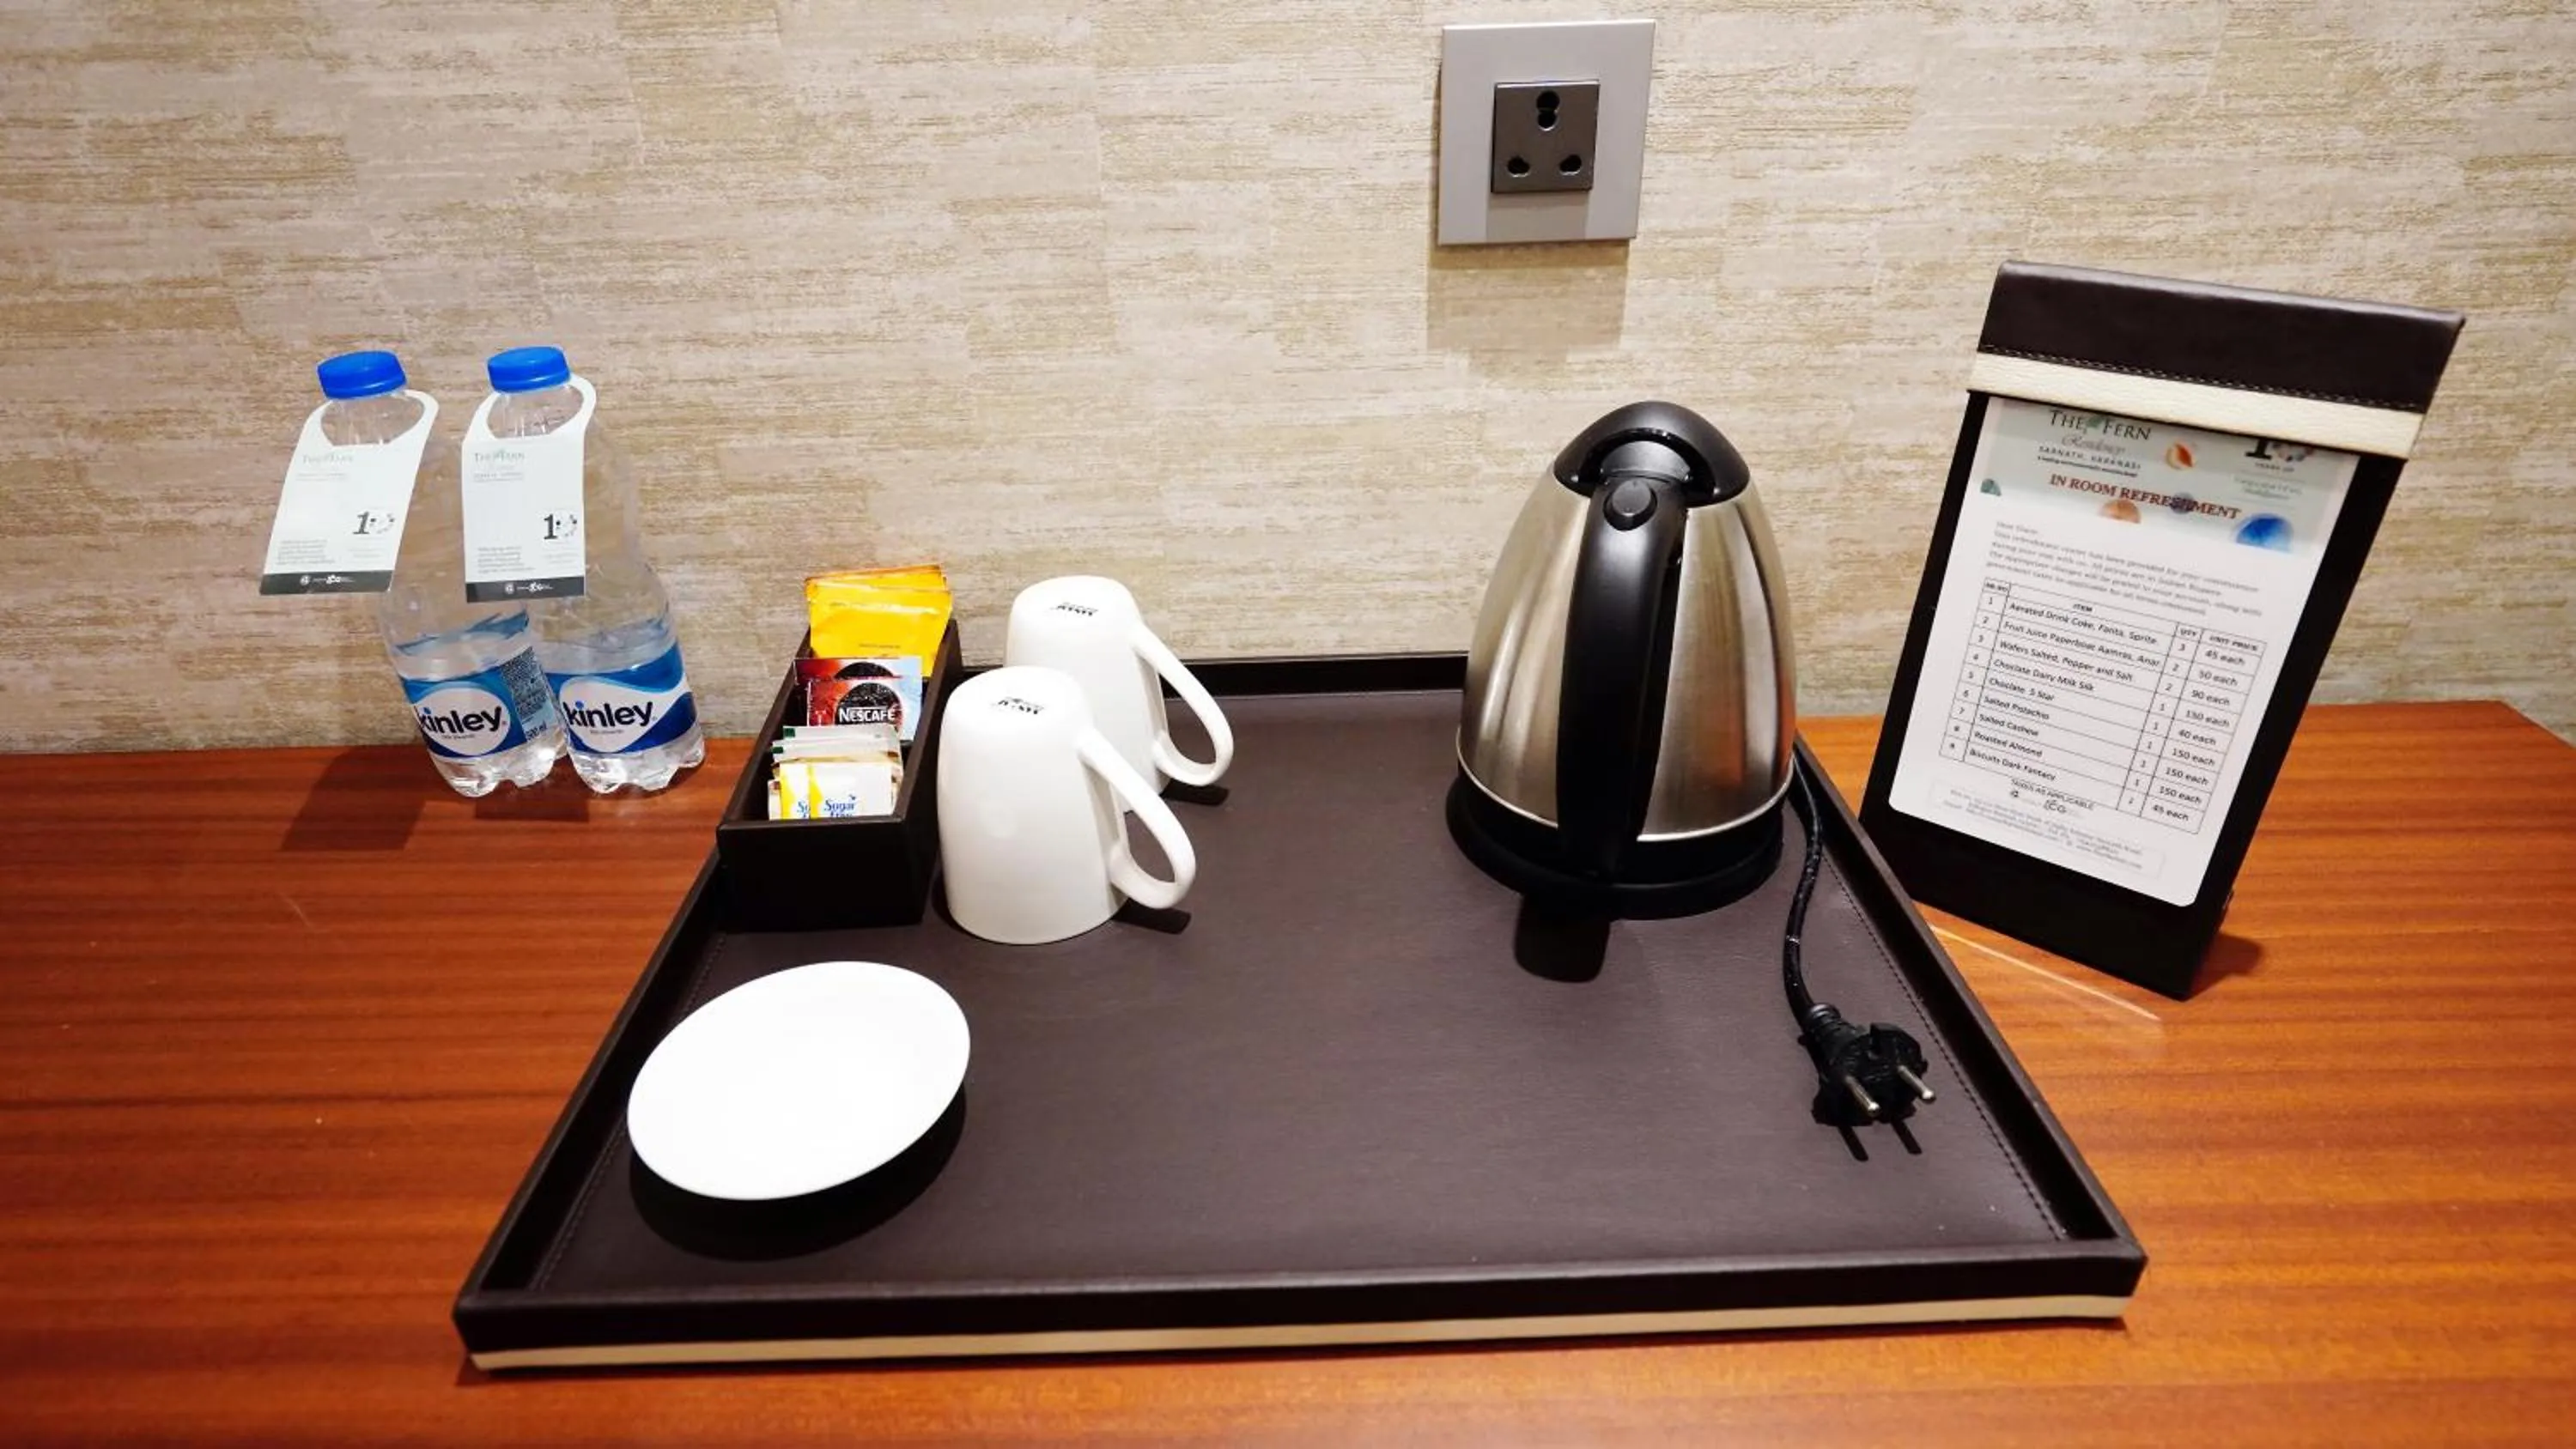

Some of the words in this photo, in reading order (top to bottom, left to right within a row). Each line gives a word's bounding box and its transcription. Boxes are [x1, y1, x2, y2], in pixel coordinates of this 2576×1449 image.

[2049, 409, 2085, 430] THE
[2103, 417, 2152, 440] FERN
[2050, 474, 2067, 487] IN
[2068, 478, 2117, 497] ROOM
[2119, 488, 2242, 518] REFRESHMENT
[2044, 609, 2069, 623] Drink
[2219, 652, 2246, 666] each
[2095, 665, 2115, 676] and
[2212, 673, 2239, 688] each
[2205, 694, 2232, 706] each
[414, 706, 502, 733] kinley
[562, 700, 653, 727] kinley
[2203, 714, 2231, 729] each
[2190, 732, 2217, 747] each
[2171, 748, 2191, 760] 150
[2190, 753, 2216, 767] each
[2165, 767, 2184, 779] 150
[2184, 772, 2210, 785] each
[2178, 791, 2202, 804] each
[823, 799, 856, 812] Sugar
[2165, 809, 2190, 822] each
